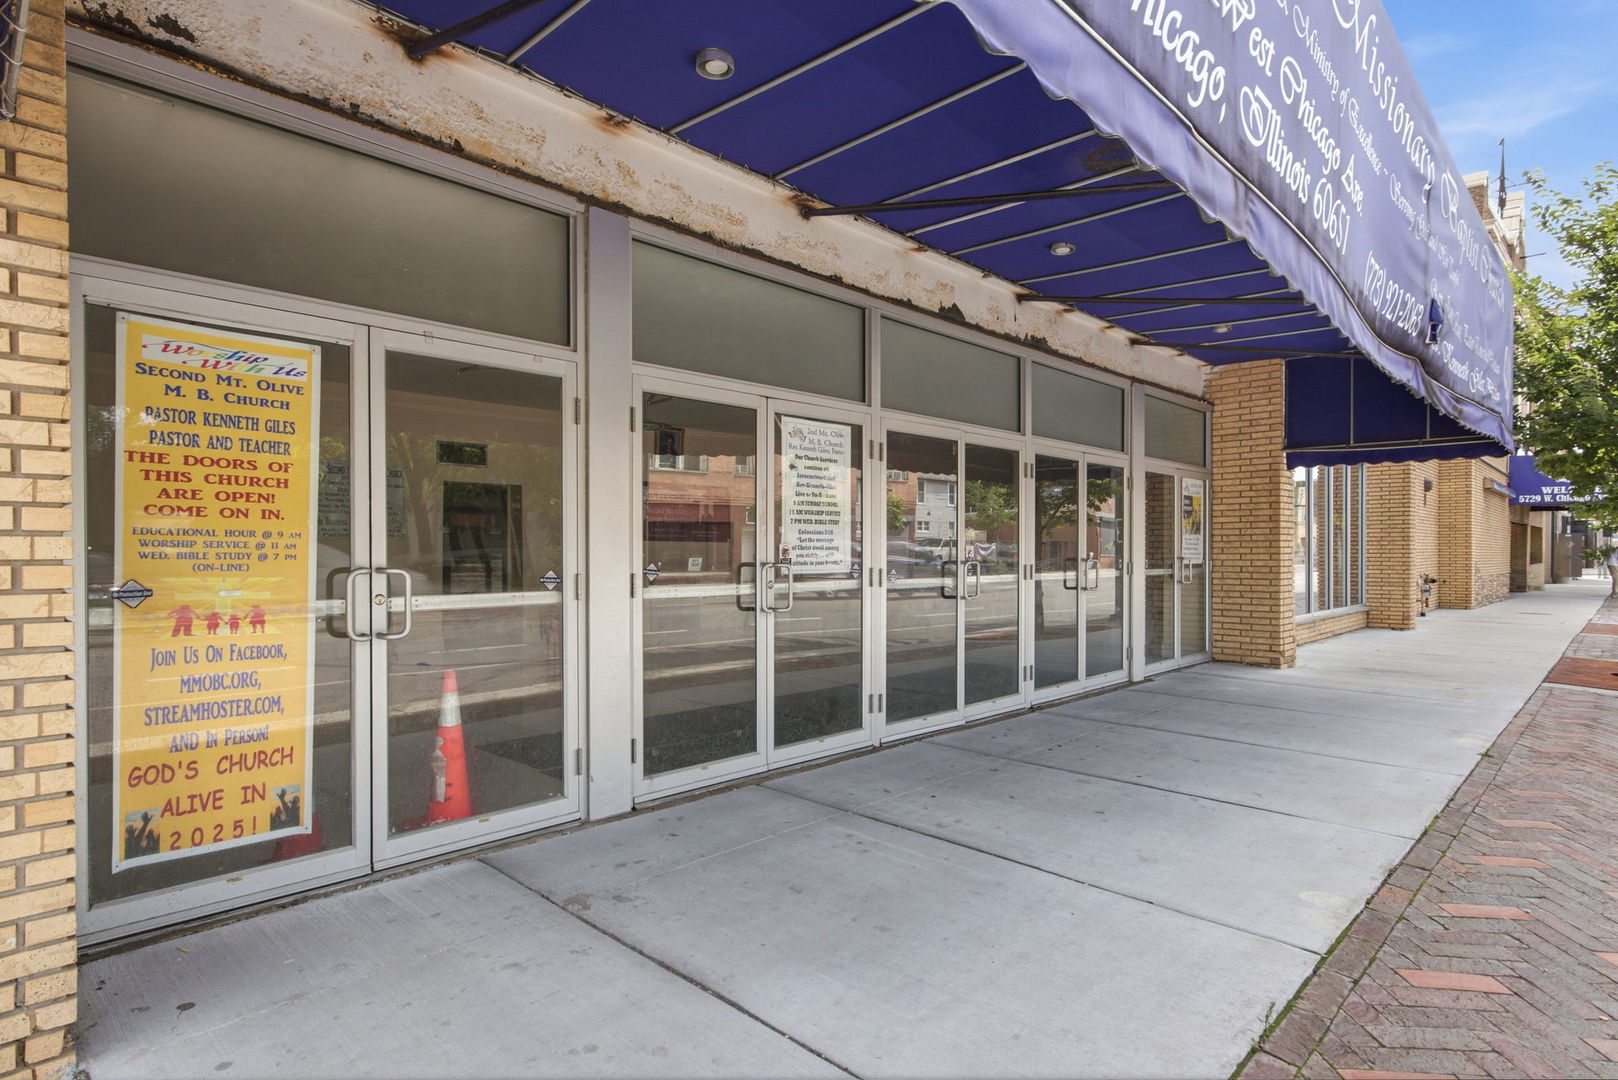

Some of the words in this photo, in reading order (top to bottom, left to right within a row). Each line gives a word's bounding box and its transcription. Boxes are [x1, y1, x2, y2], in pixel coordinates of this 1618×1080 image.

[1293, 5, 1340, 101] Ministry
[1340, 88, 1350, 117] of
[1348, 98, 1382, 176] Excellence
[1280, 56, 1341, 175] Chicago
[1341, 153, 1364, 217] Ave.
[1332, 0, 1436, 204] Missionary
[1441, 167, 1480, 272] Baptist
[1239, 85, 1311, 204] Illinois
[1313, 177, 1351, 255] 60651
[1363, 250, 1387, 312] (773)
[1382, 280, 1424, 336] 921-2063
[142, 340, 269, 364] Worship
[135, 362, 206, 383] SECOND
[256, 379, 305, 396] OLIVE
[271, 364, 308, 378] Us
[164, 384, 187, 399] M.
[197, 389, 214, 402] B.
[223, 392, 291, 411] CHURCH
[145, 406, 197, 425] PASTOR
[203, 412, 260, 432] KENNETH
[265, 419, 296, 436] GILES
[807, 427, 818, 436] 2nd
[149, 430, 201, 449] PASTOR
[206, 435, 233, 451] AND
[238, 437, 292, 456] TEACHER
[824, 439, 844, 448] Church
[124, 450, 171, 465] THE
[183, 454, 259, 471] DOORS
[268, 461, 295, 474] OF
[820, 456, 838, 464] Services
[139, 469, 193, 483] THIS
[204, 473, 290, 489] CHURCH
[156, 488, 204, 501] ARE
[214, 491, 276, 504] OPEN!
[1518, 494, 1541, 503] 5729
[1543, 494, 1554, 502] W.
[143, 504, 209, 518] COME
[219, 507, 250, 519] ON
[261, 509, 286, 521] IN.
[132, 526, 218, 537] EDUCATIONAL
[224, 529, 258, 538] HOUR
[262, 530, 273, 539] @
[277, 531, 284, 539] 9
[137, 551, 170, 560] WED.
[176, 551, 209, 560] BIBLE
[215, 551, 252, 561] STUDY
[257, 552, 268, 562] @
[273, 553, 280, 561] 7
[284, 553, 297, 561] PM
[138, 539, 197, 548] WORSHIP
[202, 540, 250, 549] SERVICE
[255, 541, 266, 551] @
[192, 563, 250, 573] (ON-LINE)
[151, 648, 177, 672] JOIN
[183, 645, 199, 663] US
[206, 645, 223, 662] ON
[229, 643, 288, 662] FACEBOOK,
[180, 670, 262, 693] MMOBC.ORG,
[144, 695, 285, 726] STREAMHOSTER.COM,
[169, 731, 200, 753] AND
[206, 730, 218, 748] IN
[224, 724, 269, 746] PERSON!
[127, 760, 199, 788] GOD'S
[216, 745, 294, 775] CHURCH
[160, 788, 224, 818] ALIVE
[240, 782, 266, 805] IN
